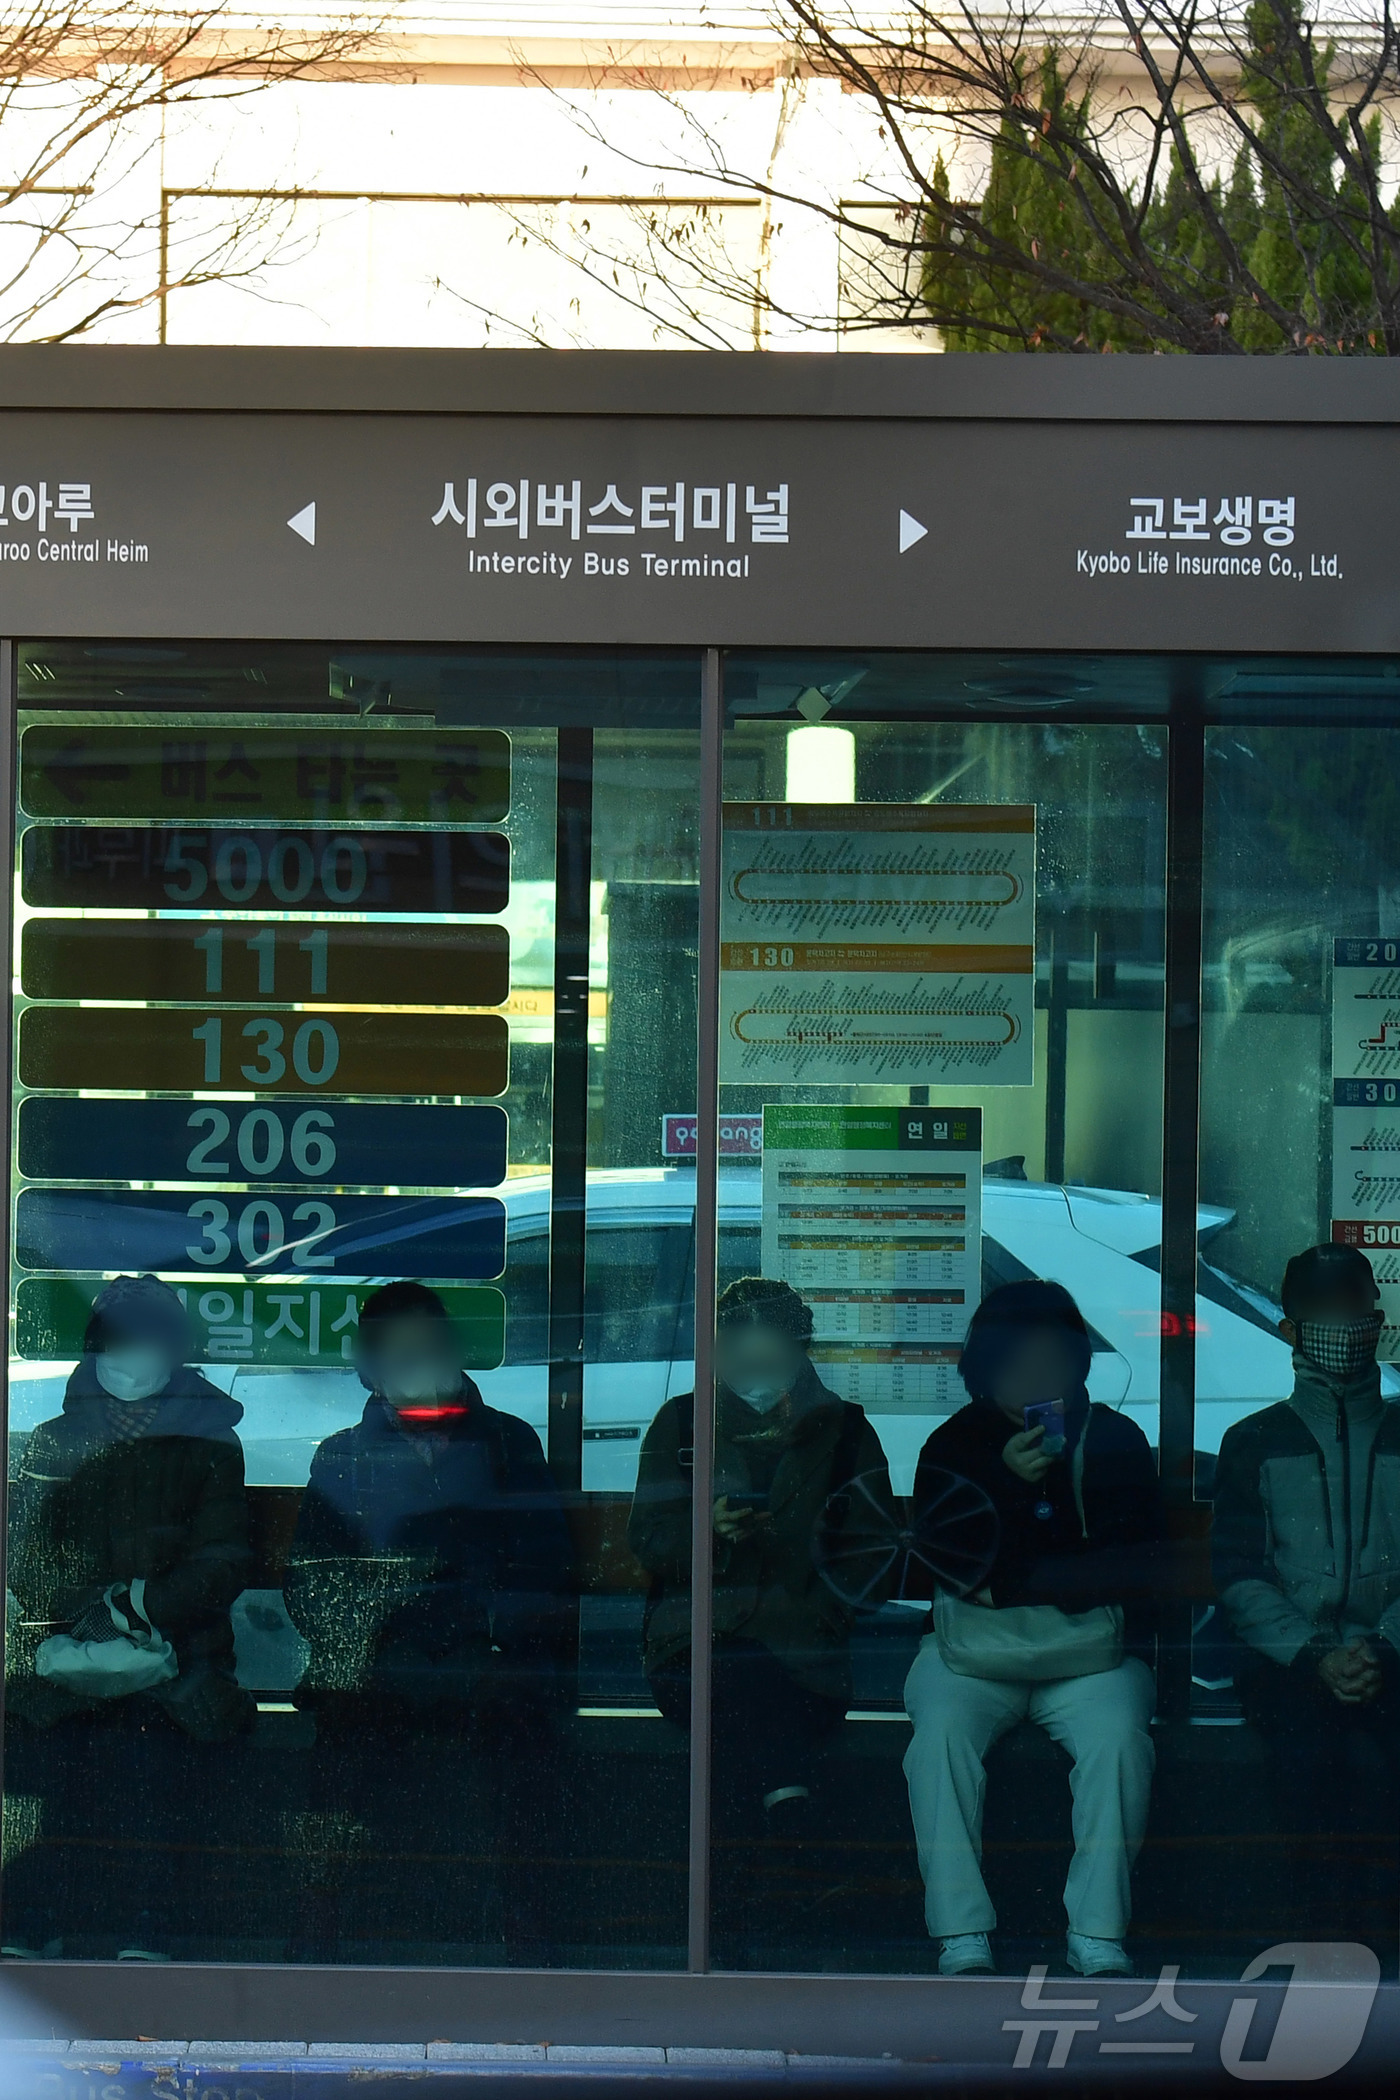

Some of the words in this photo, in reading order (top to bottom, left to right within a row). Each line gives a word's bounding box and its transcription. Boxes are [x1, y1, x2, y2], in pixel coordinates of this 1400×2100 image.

[0, 482, 95, 532] 아루
[432, 479, 790, 543] 시외버스터미널
[1126, 496, 1295, 546] 교보생명
[38, 538, 99, 562] Central
[107, 539, 148, 562] Heim
[469, 550, 572, 579] Intercity
[585, 552, 629, 576] Bus
[641, 554, 749, 578] Terminal
[1077, 550, 1131, 578] Kyobo
[1138, 551, 1168, 575] Life
[1176, 552, 1262, 576] Insurance
[1269, 553, 1302, 581] Co.,
[1311, 554, 1343, 579] Ltd.
[161, 740, 262, 802] 버스
[296, 741, 398, 804] 타는
[432, 744, 483, 804] 곳
[753, 807, 793, 826] 111
[163, 836, 367, 904] 5000
[194, 927, 328, 994] 111
[750, 947, 794, 966] 130
[192, 1017, 340, 1085] 130
[186, 1108, 336, 1176] 206
[185, 1199, 336, 1268] 302
[177, 1288, 360, 1360] 일지
